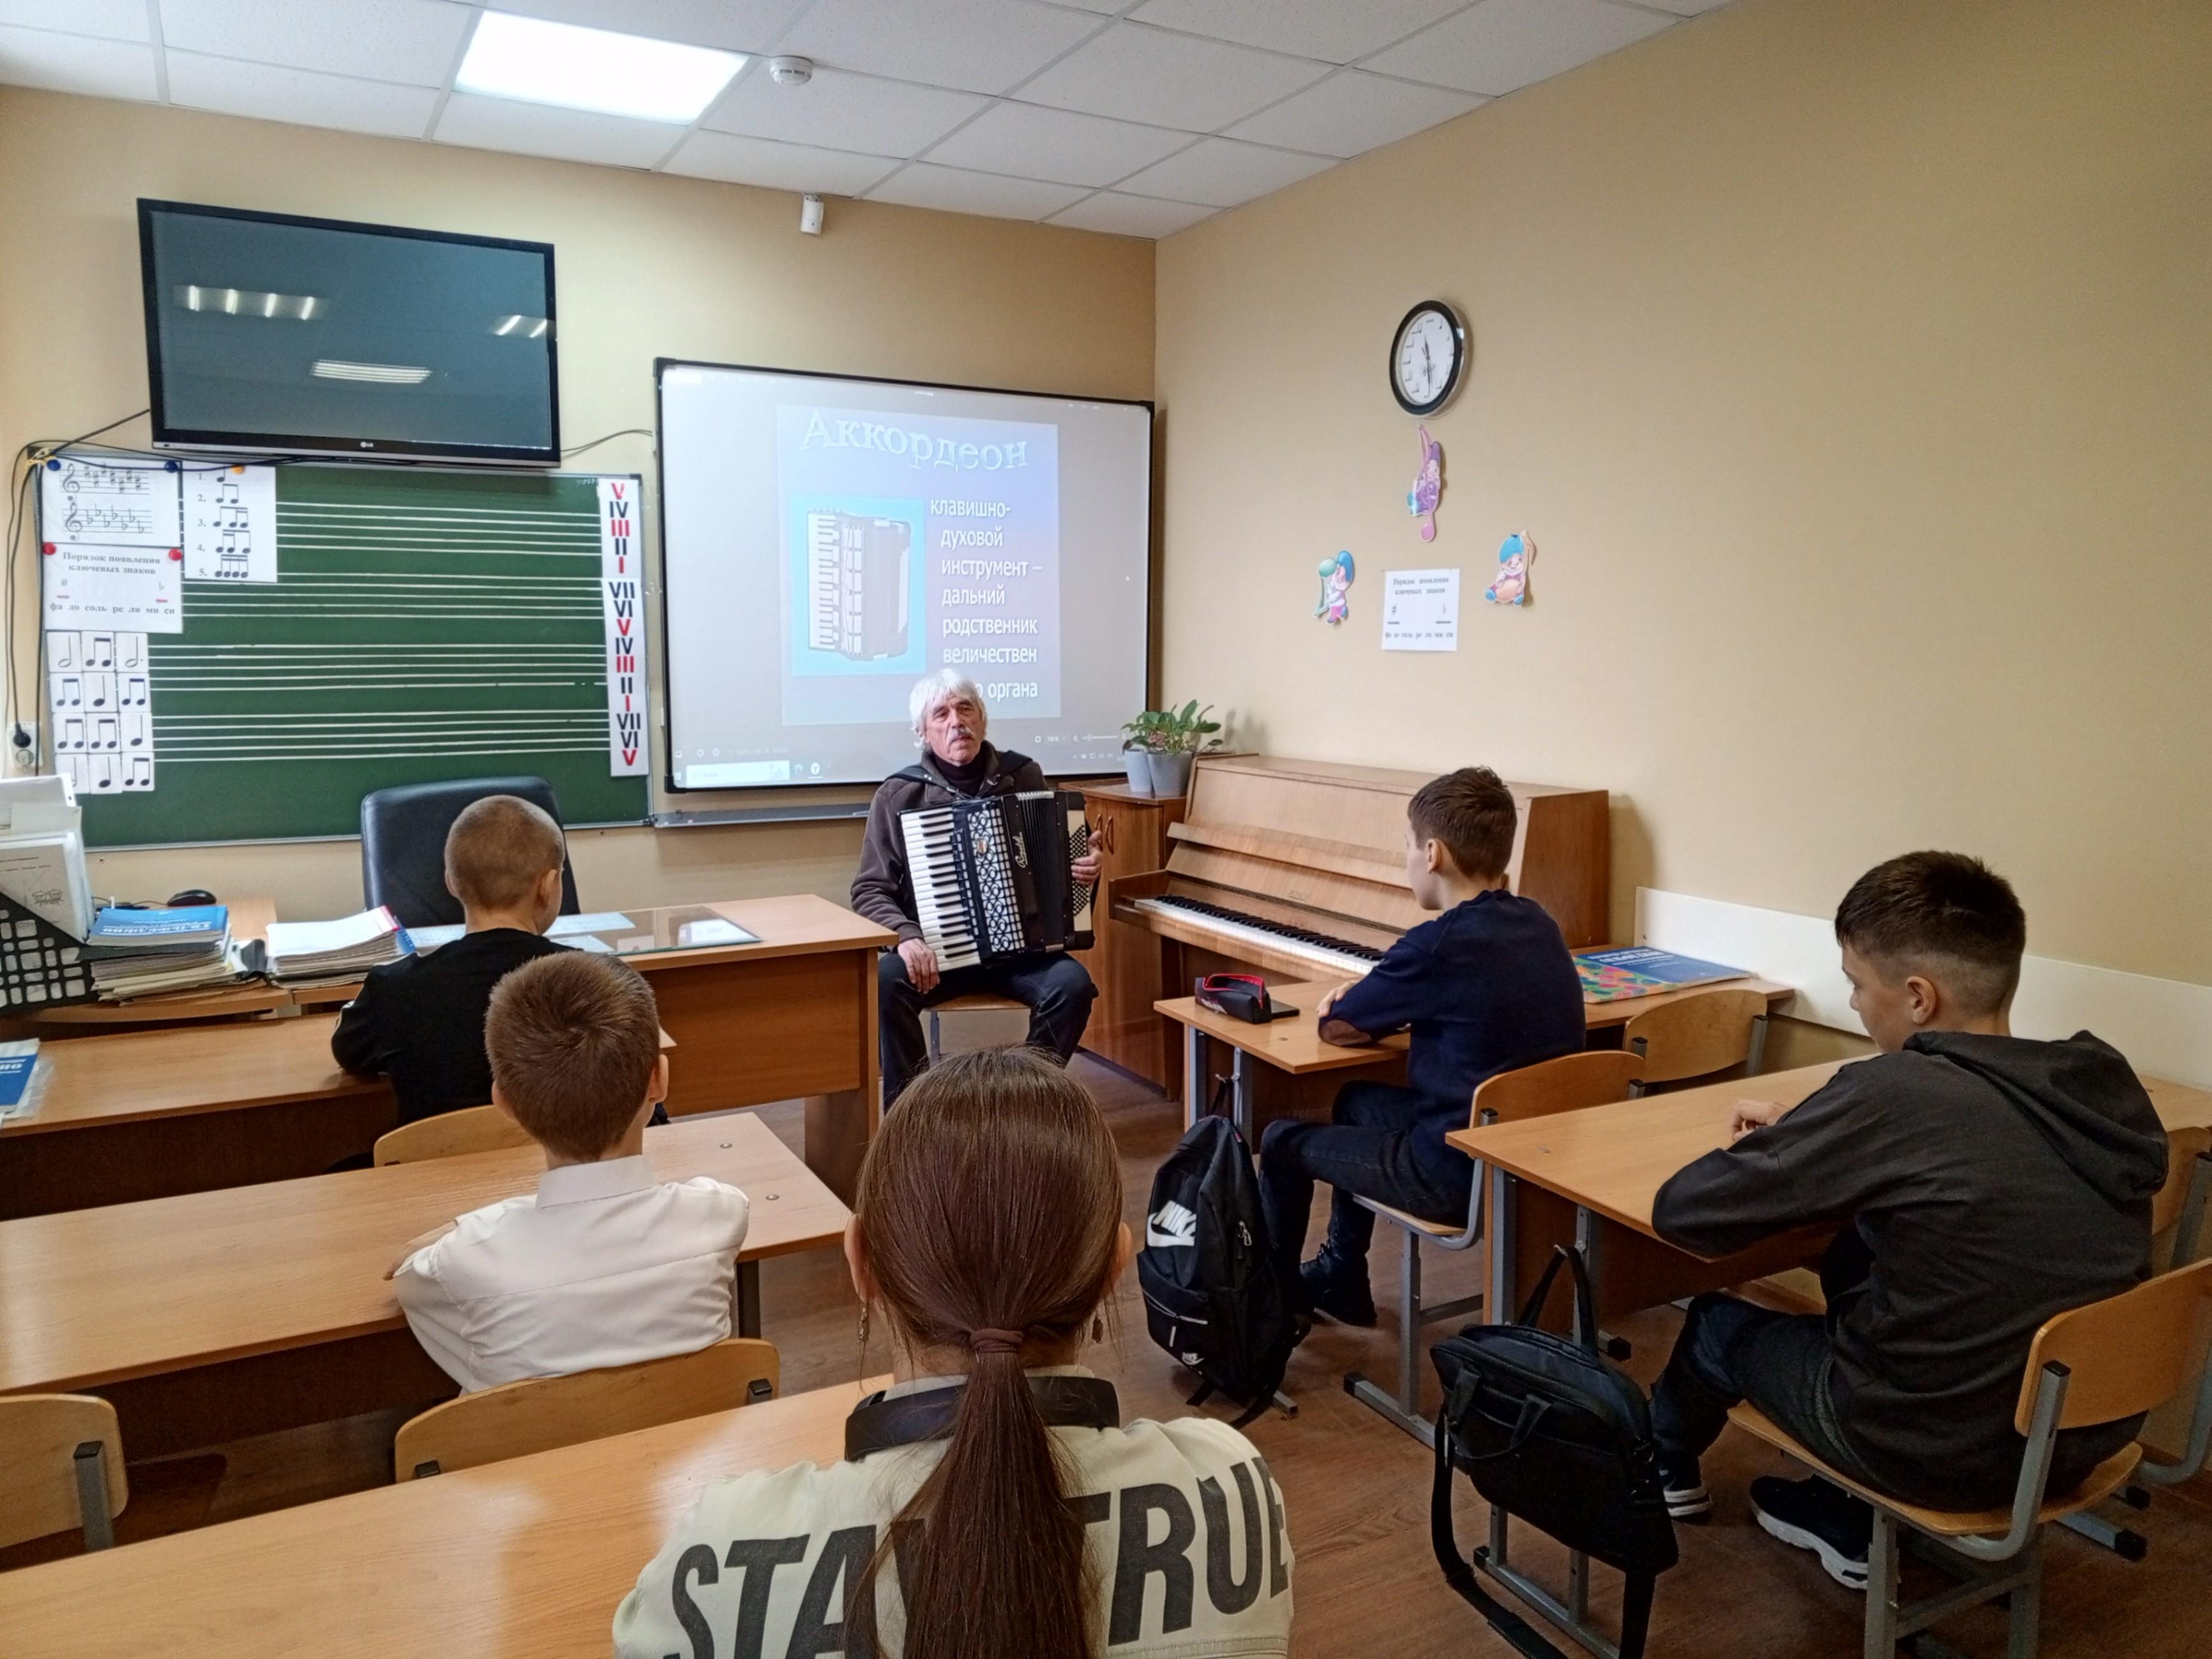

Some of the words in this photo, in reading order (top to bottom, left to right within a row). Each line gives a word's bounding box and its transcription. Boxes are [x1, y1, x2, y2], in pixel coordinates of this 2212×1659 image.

[800, 409, 1029, 472] Аккордеон
[611, 483, 625, 499] V
[610, 502, 628, 518] IV
[931, 499, 1011, 518] клавишно-
[611, 520, 629, 537] III
[615, 538, 627, 555] II
[941, 526, 1003, 550] духовой
[197, 544, 206, 552] 4.
[63, 552, 106, 562] Порядок
[68, 564, 119, 573] ключевых
[942, 559, 1028, 580] инструмент
[609, 582, 635, 599] VII
[942, 583, 1005, 606] дальний
[49, 603, 63, 612] фа
[112, 606, 123, 614] ре
[613, 600, 633, 617] VI
[617, 619, 631, 636] V
[943, 618, 1038, 638] родственник
[615, 637, 633, 654] IV
[943, 647, 1037, 663] величествен
[616, 656, 635, 673] III
[621, 677, 633, 694] II
[988, 682, 1038, 702] органа
[617, 713, 641, 730] VII
[621, 732, 638, 748] VI
[621, 749, 636, 765] V
